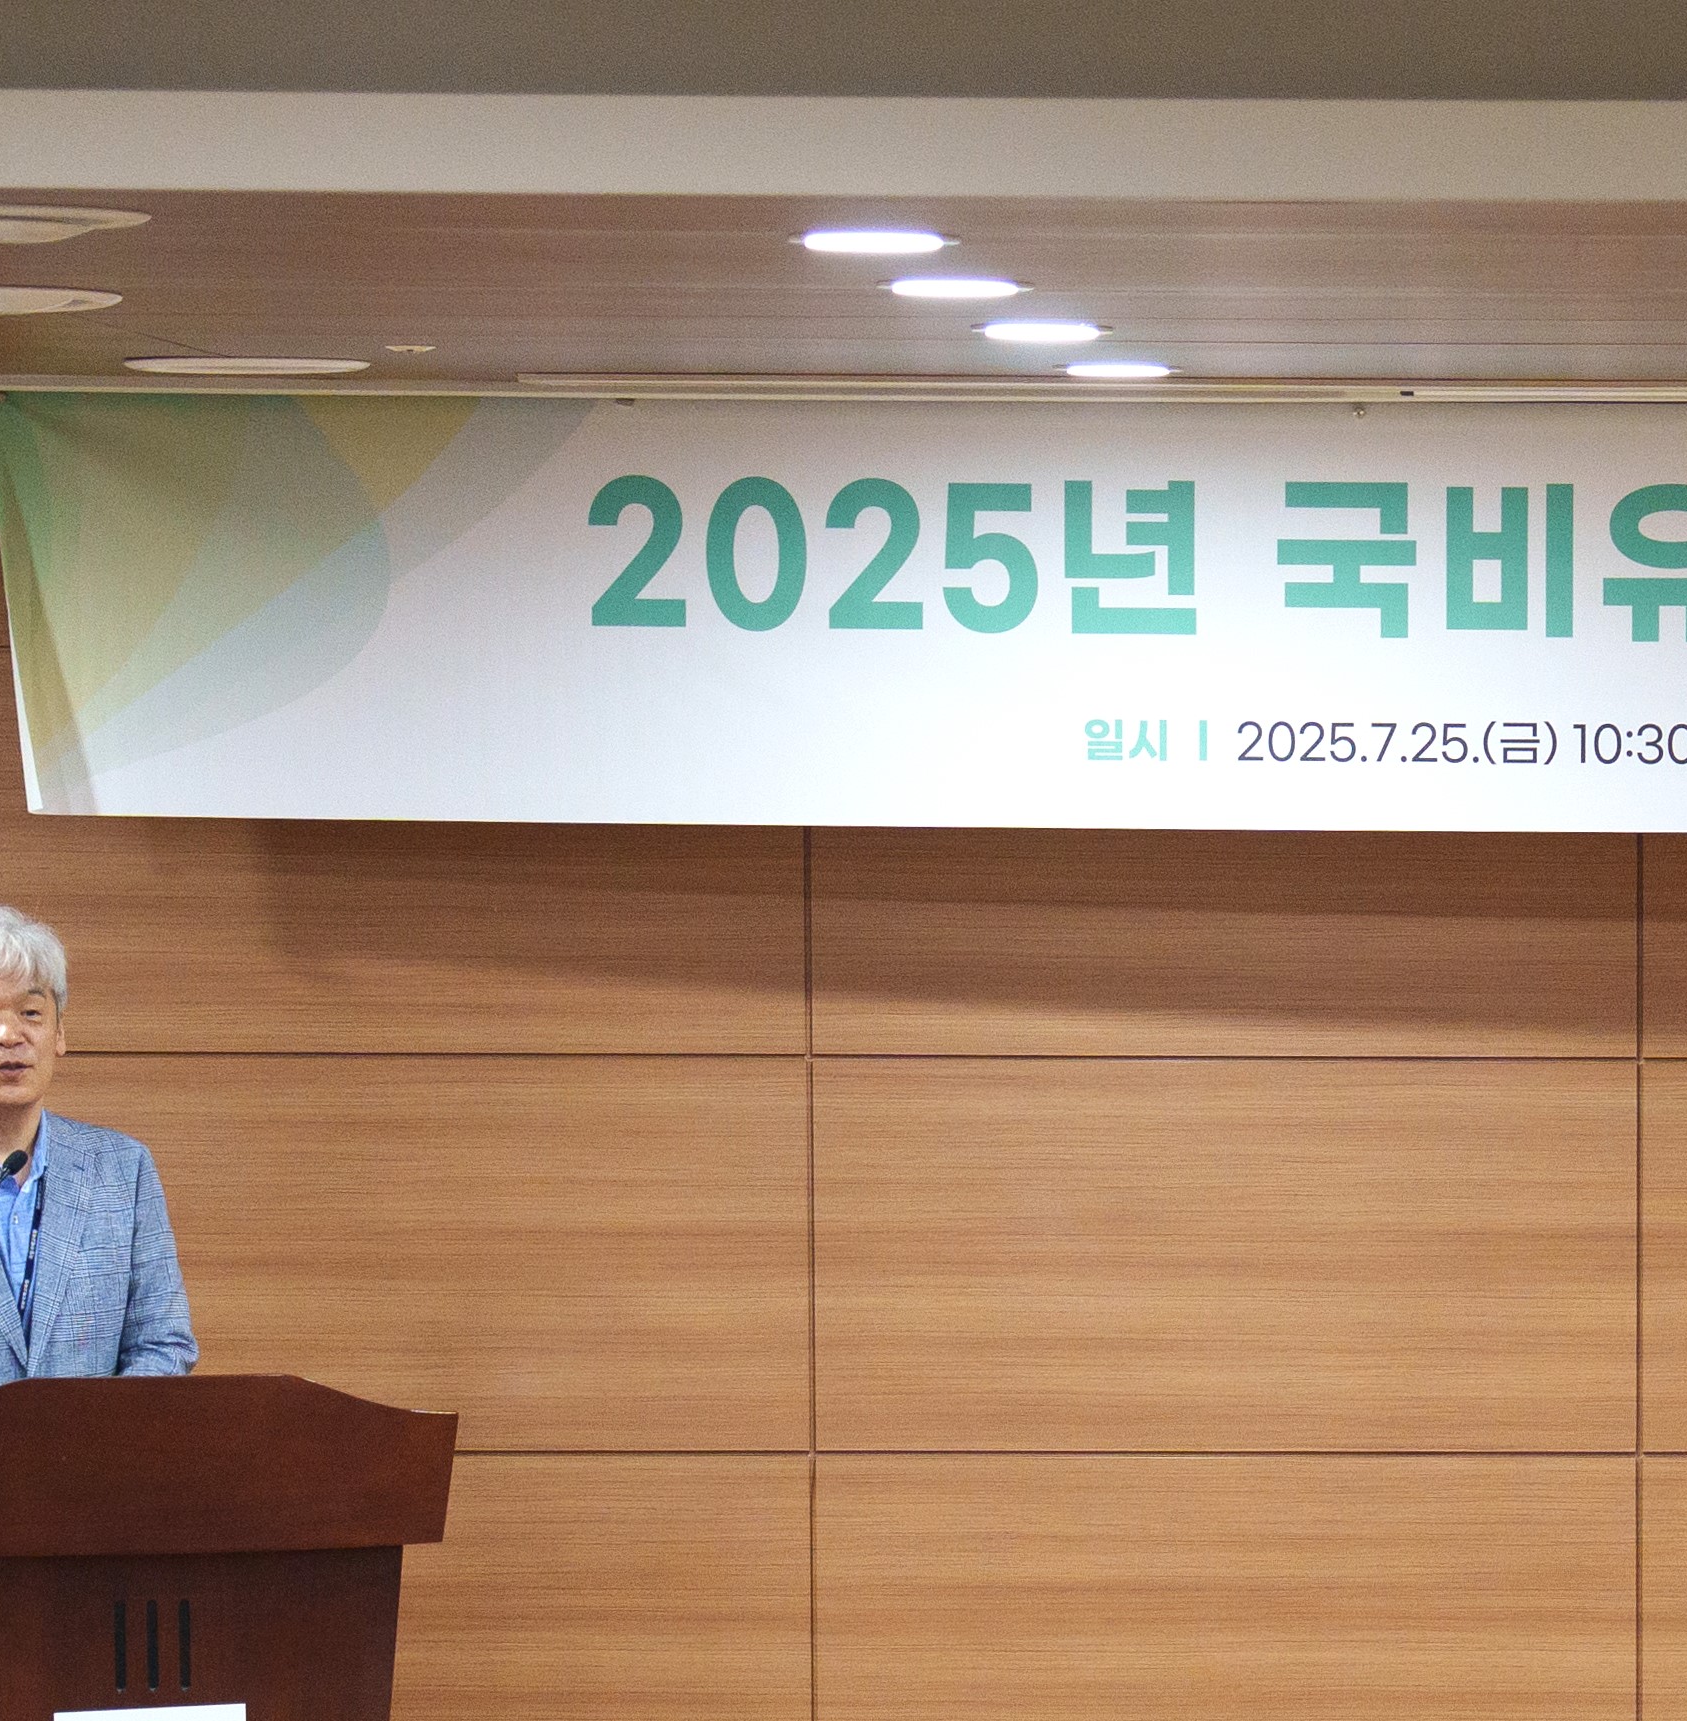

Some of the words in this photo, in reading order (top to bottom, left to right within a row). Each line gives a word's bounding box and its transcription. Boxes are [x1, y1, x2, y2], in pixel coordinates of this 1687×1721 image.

[585, 475, 1198, 636] 2025년
[1083, 718, 1169, 762] 일시
[1236, 720, 1560, 767] 2025.7.25.(금)
